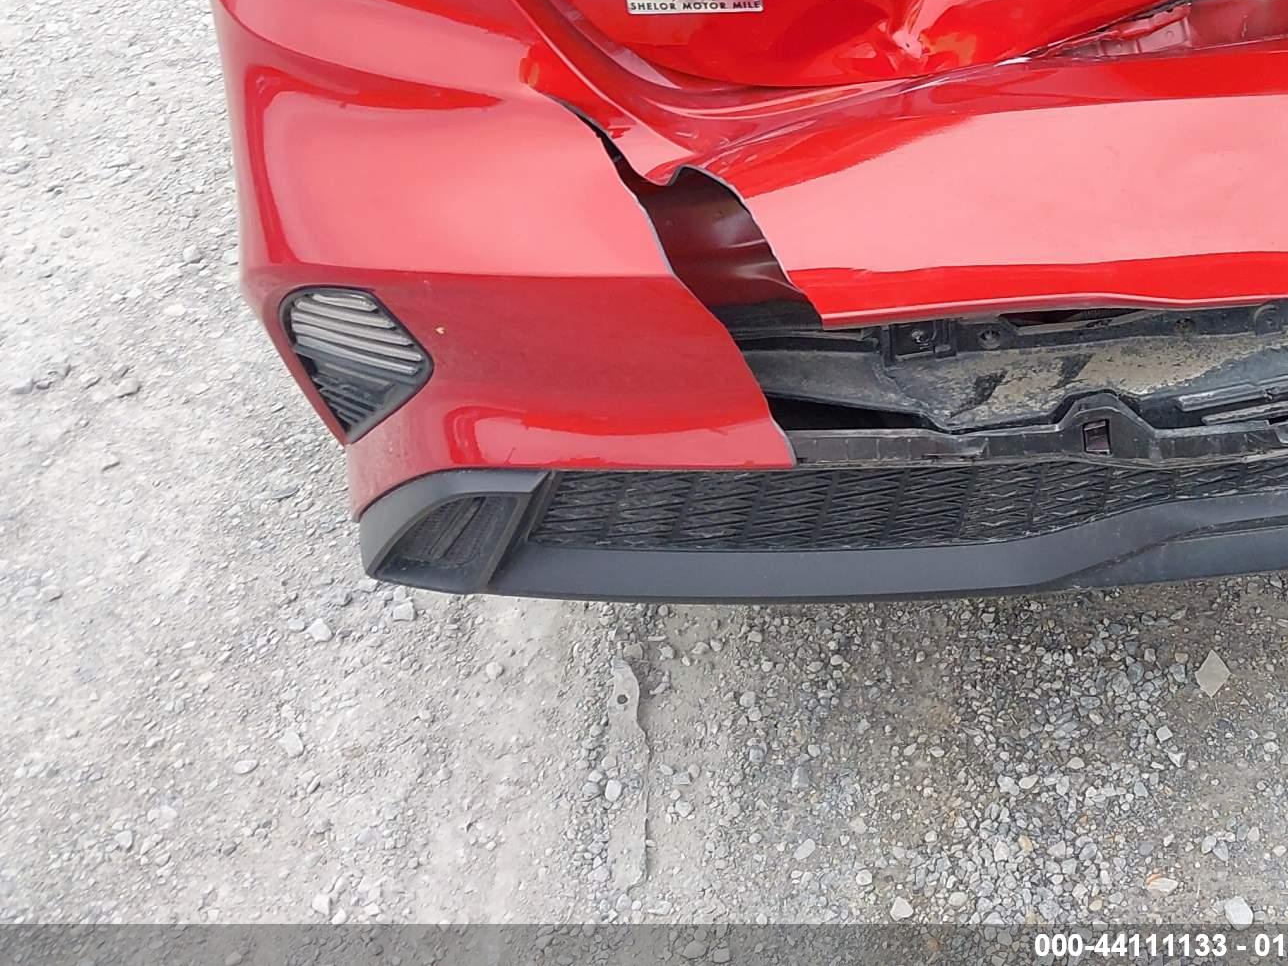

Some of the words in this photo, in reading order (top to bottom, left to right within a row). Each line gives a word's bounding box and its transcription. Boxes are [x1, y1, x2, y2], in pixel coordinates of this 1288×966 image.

[630, 1, 677, 11] SHELOR
[682, 1, 727, 10] MOTOR
[732, 0, 760, 9] MILE
